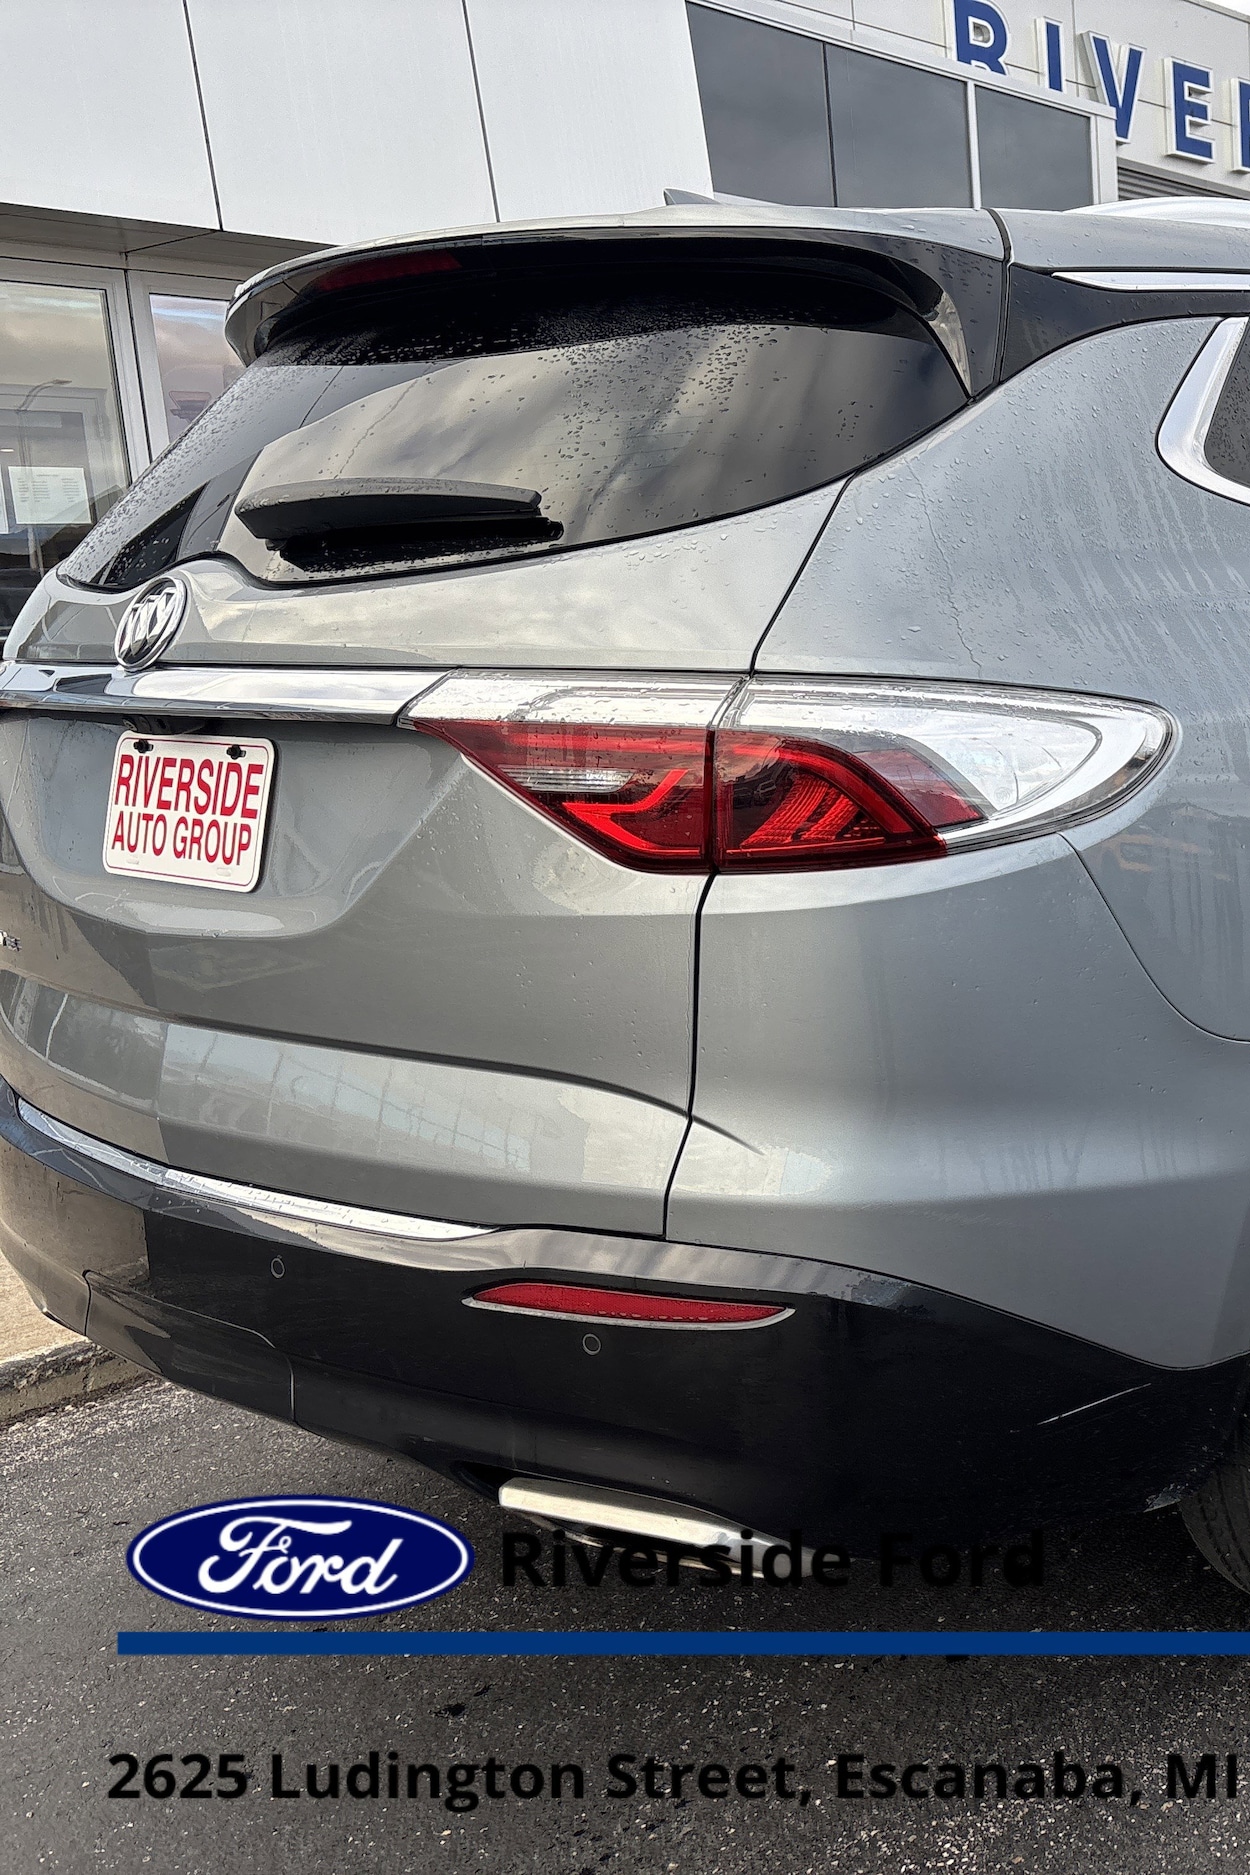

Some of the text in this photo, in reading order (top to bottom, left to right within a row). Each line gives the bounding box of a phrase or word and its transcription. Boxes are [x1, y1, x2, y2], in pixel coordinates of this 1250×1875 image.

[114, 754, 264, 819] RIVERSIDE
[112, 811, 252, 865] AUTO GROUP
